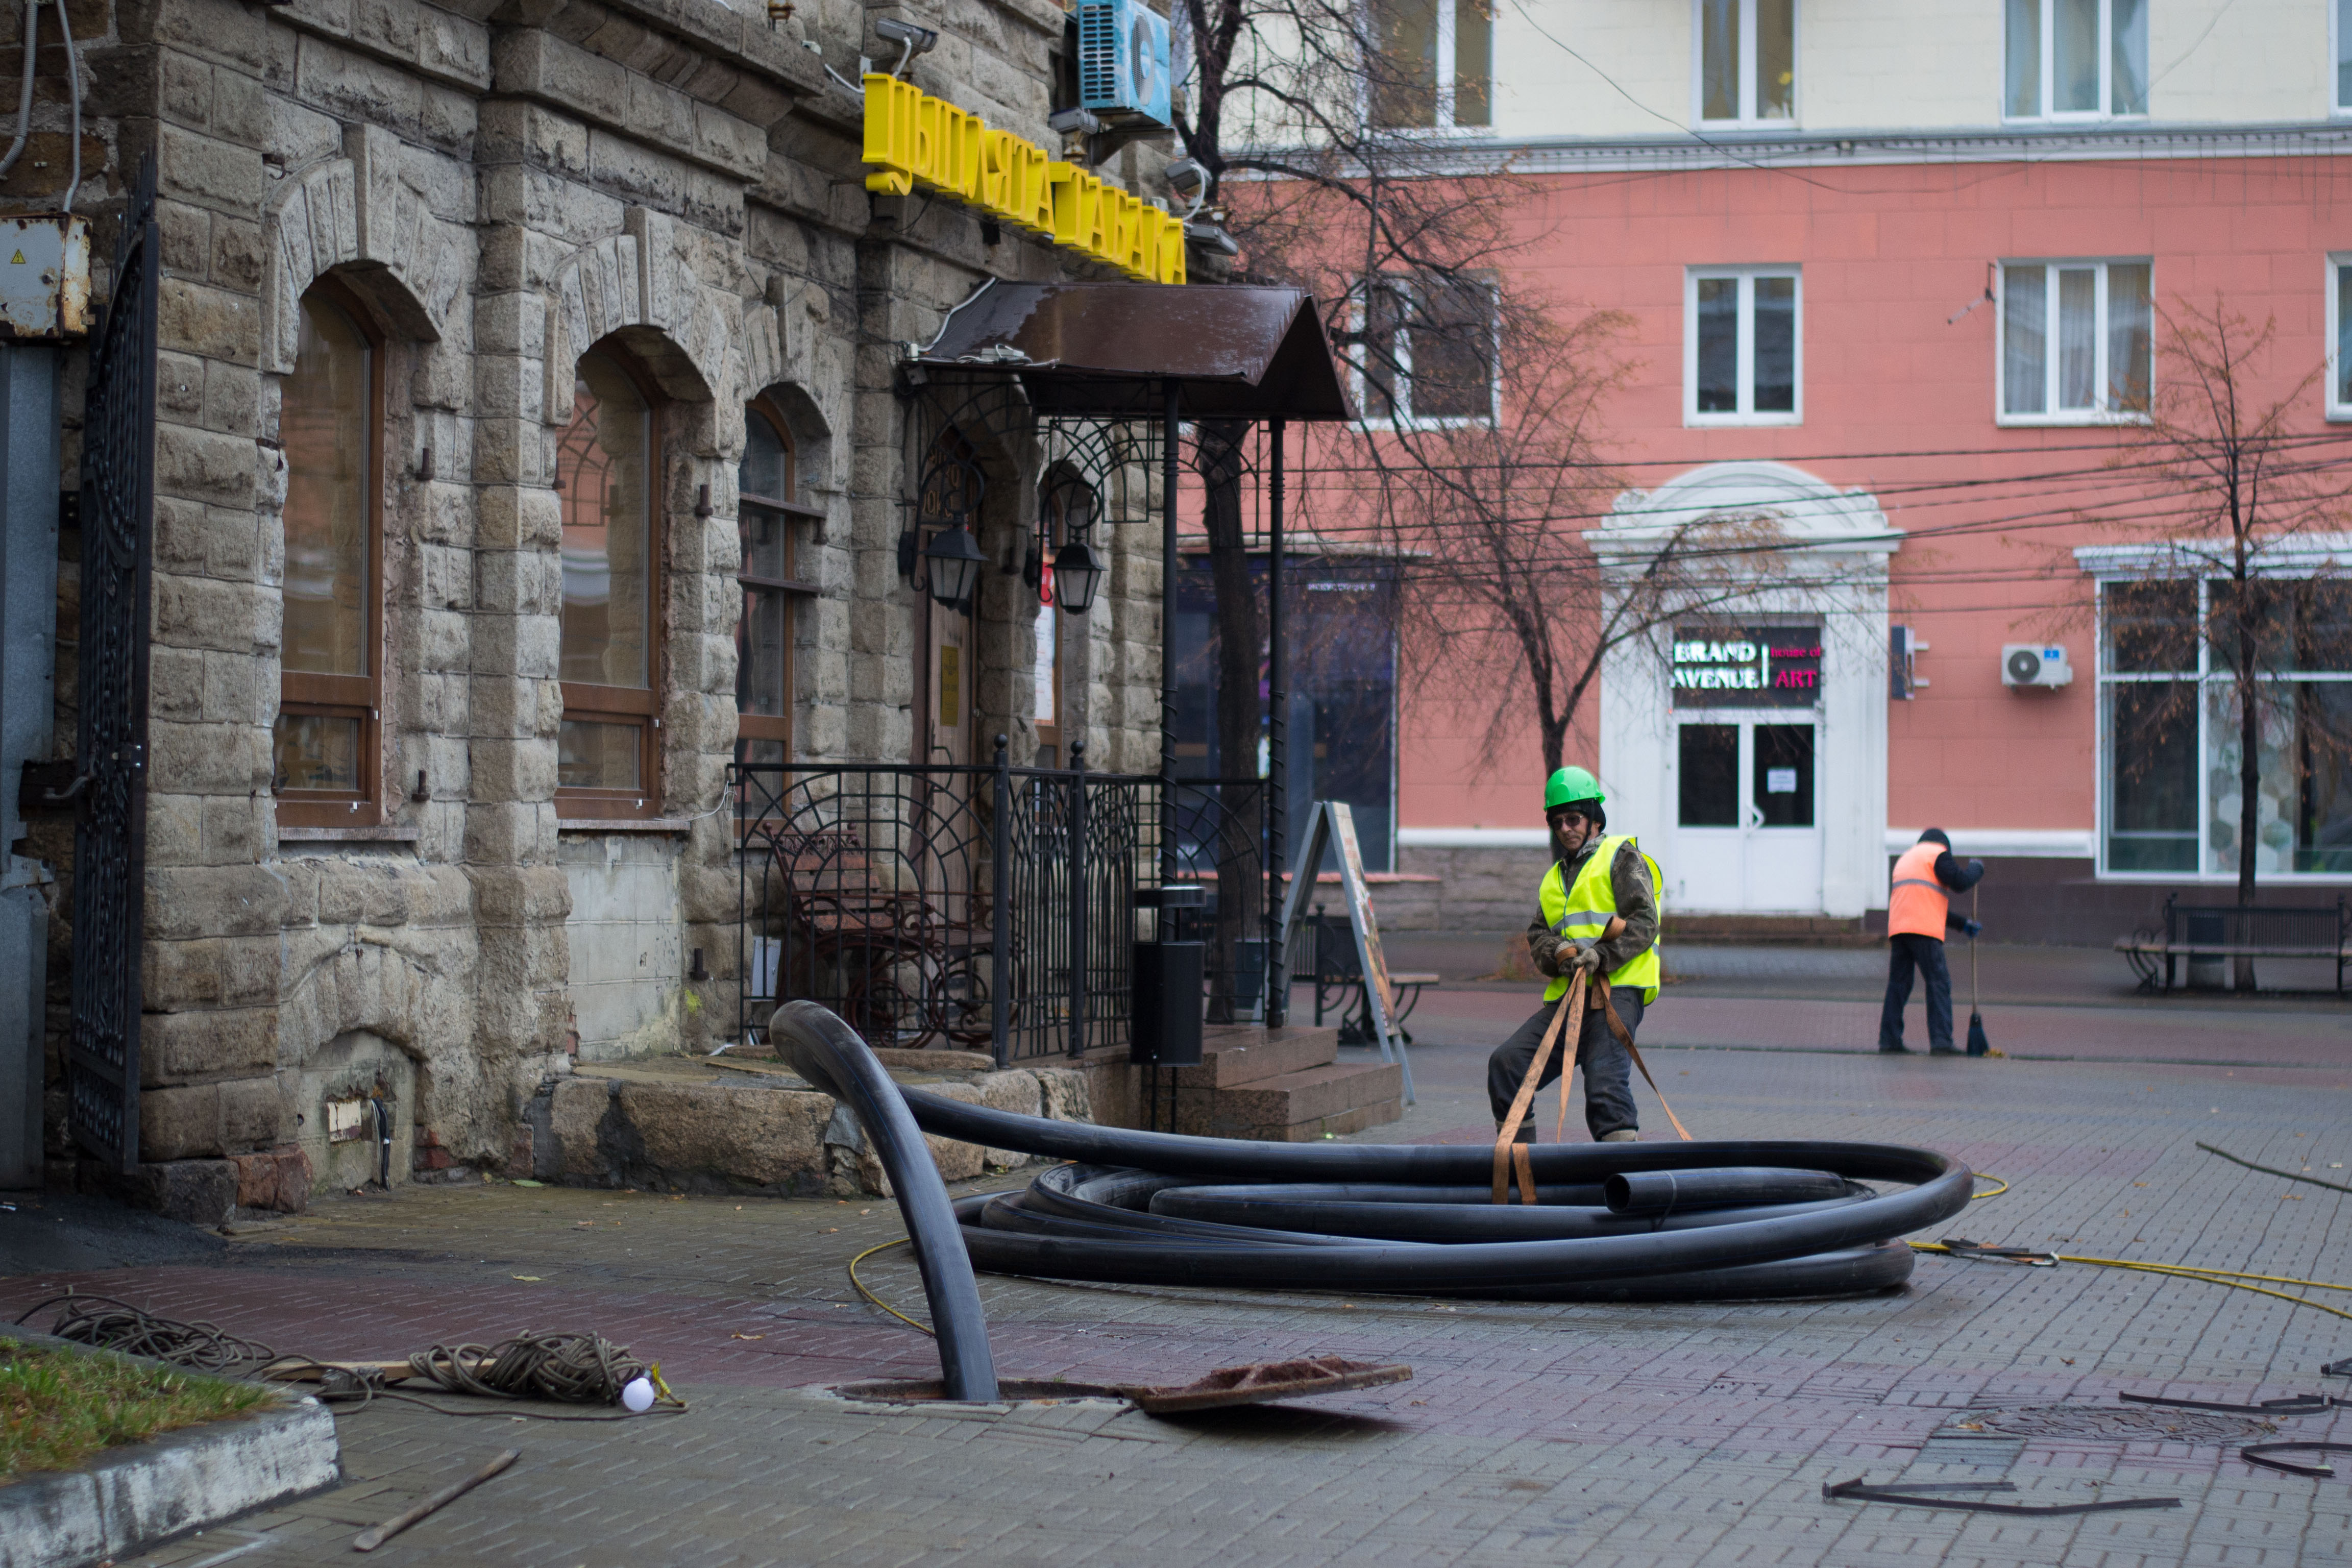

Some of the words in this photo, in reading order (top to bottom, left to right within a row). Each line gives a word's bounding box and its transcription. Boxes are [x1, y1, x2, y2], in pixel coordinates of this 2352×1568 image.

[863, 74, 1056, 235] ЦЫПЛЯТА
[1050, 162, 1186, 285] ТАБАКА
[1674, 640, 1756, 663] BRAND
[1770, 646, 1806, 658] house
[1669, 667, 1760, 689] AVENUE
[1775, 669, 1817, 688] ART
